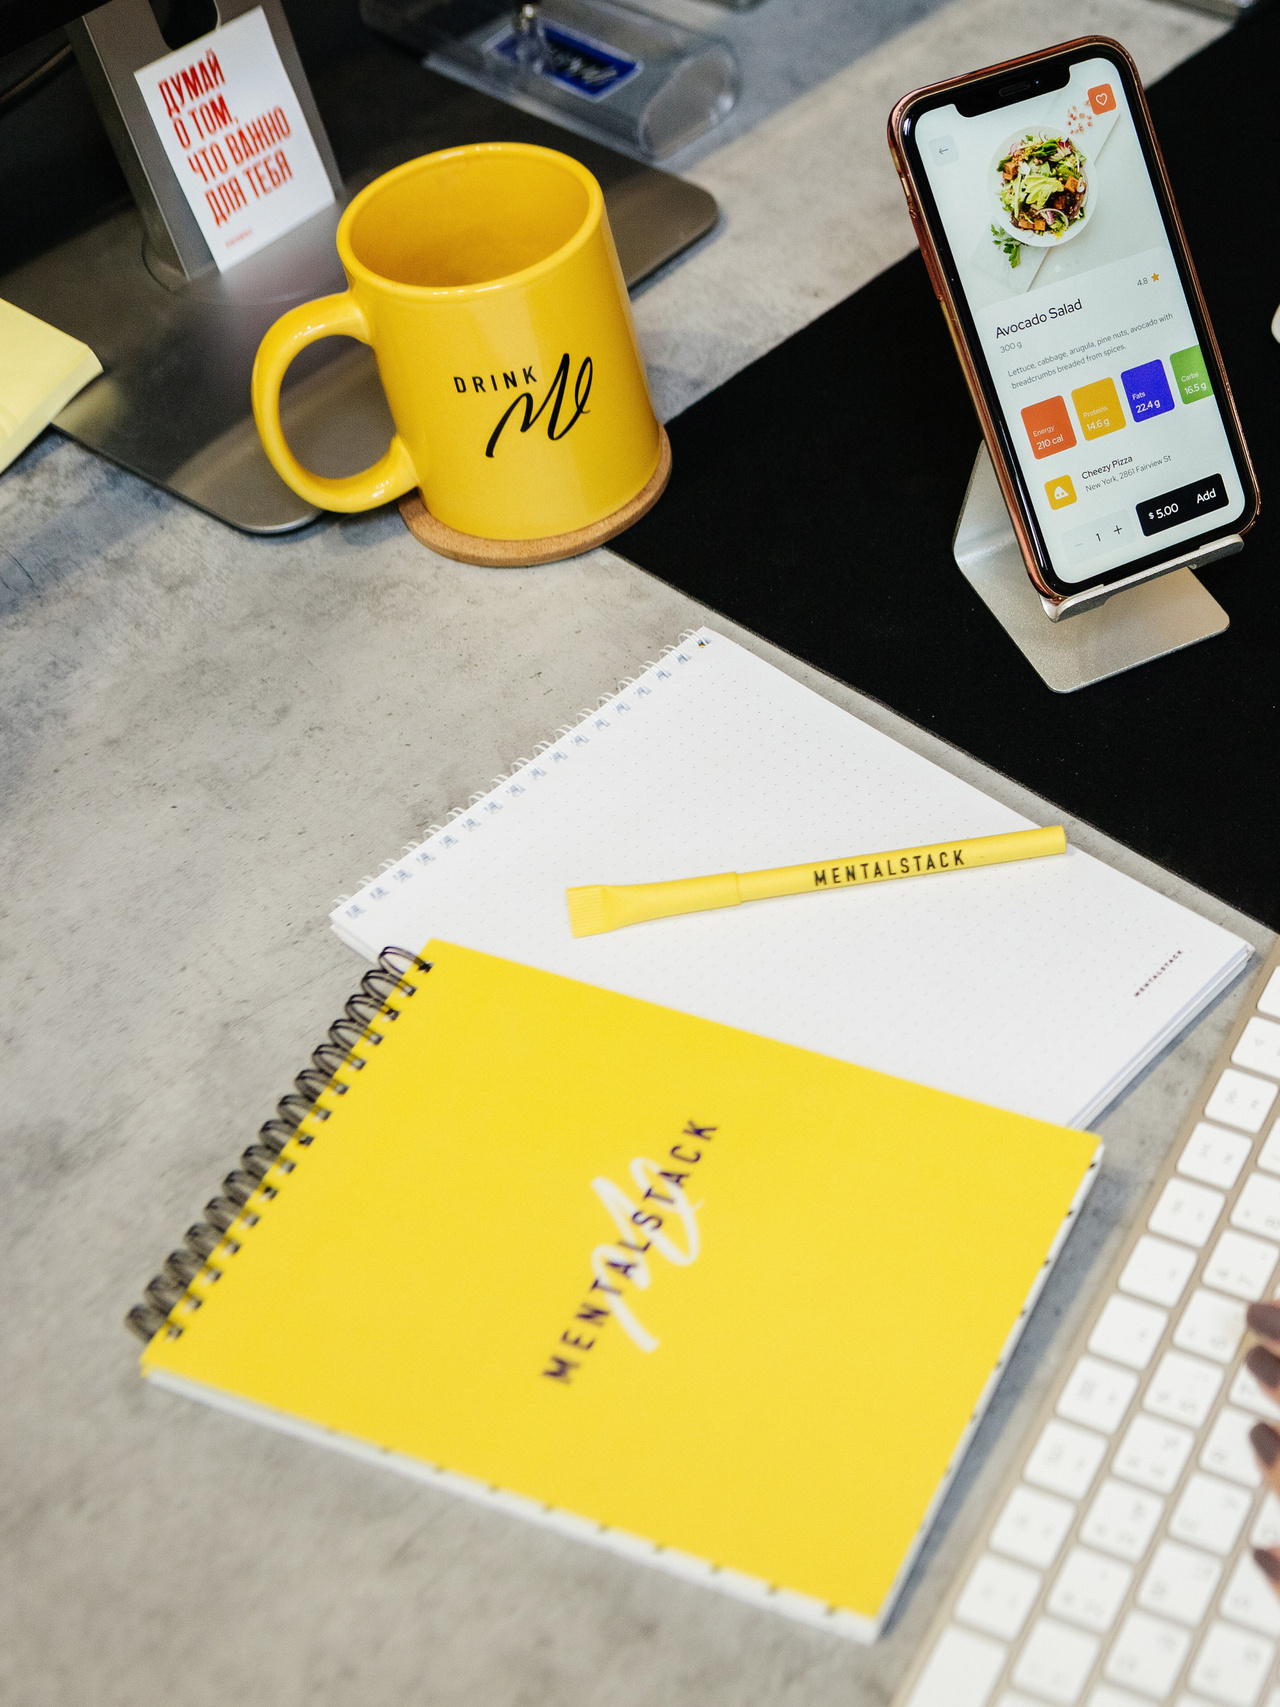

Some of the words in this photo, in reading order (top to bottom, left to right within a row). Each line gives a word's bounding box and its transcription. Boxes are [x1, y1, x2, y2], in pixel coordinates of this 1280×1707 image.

[158, 48, 226, 118] ДУМАЙ
[172, 118, 191, 150] О
[188, 93, 239, 140] ТОМ,
[187, 142, 228, 184] ЧТО
[224, 106, 291, 167] ВАЖНО
[205, 175, 248, 227] ДЛЯ
[243, 149, 293, 200] ТЕБЯ
[1136, 277, 1149, 287] 4.8
[995, 313, 1048, 339] Avocado
[1049, 298, 1083, 319] Salad
[1000, 342, 1015, 354] 300
[1015, 341, 1023, 351] g
[1007, 362, 1037, 378] Lettuce,
[1037, 351, 1069, 369] cabbage,
[1069, 341, 1096, 359] arugula,
[1097, 335, 1112, 348] pine
[1113, 329, 1129, 341] nuts,
[1130, 319, 1158, 334] avocado
[1159, 312, 1174, 326] with
[453, 365, 537, 393] DRINK
[1011, 370, 1056, 390] breadcrumbs
[1056, 357, 1085, 373] breaded
[1086, 351, 1103, 364] from
[1103, 345, 1126, 360] spices.
[1181, 371, 1199, 383] Carbs
[1132, 391, 1146, 401] Fats
[1184, 383, 1200, 395] 16.5
[1200, 381, 1207, 392] g
[1083, 405, 1108, 419] Proteins
[1136, 401, 1154, 413] 22.4
[1153, 399, 1161, 409] g
[1033, 424, 1055, 437] Energy
[1086, 420, 1103, 431] 14.6
[1102, 418, 1110, 428] g
[1037, 437, 1052, 451] 210
[1051, 433, 1064, 445] cal
[1081, 464, 1111, 480] Cheezy
[1111, 455, 1133, 469] Pizza
[1085, 481, 1102, 492] New
[1101, 475, 1119, 487] York,
[1119, 470, 1135, 480] 2861
[1135, 460, 1162, 474] Fairview
[1162, 455, 1172, 464] St
[1155, 503, 1179, 519] 5.00
[1196, 488, 1217, 504] Add
[1095, 532, 1102, 542] 1
[813, 849, 965, 887] MENTALSTACK
[1134, 950, 1184, 997] MENTALSTACK
[540, 1119, 719, 1386] MENTALSTACK
